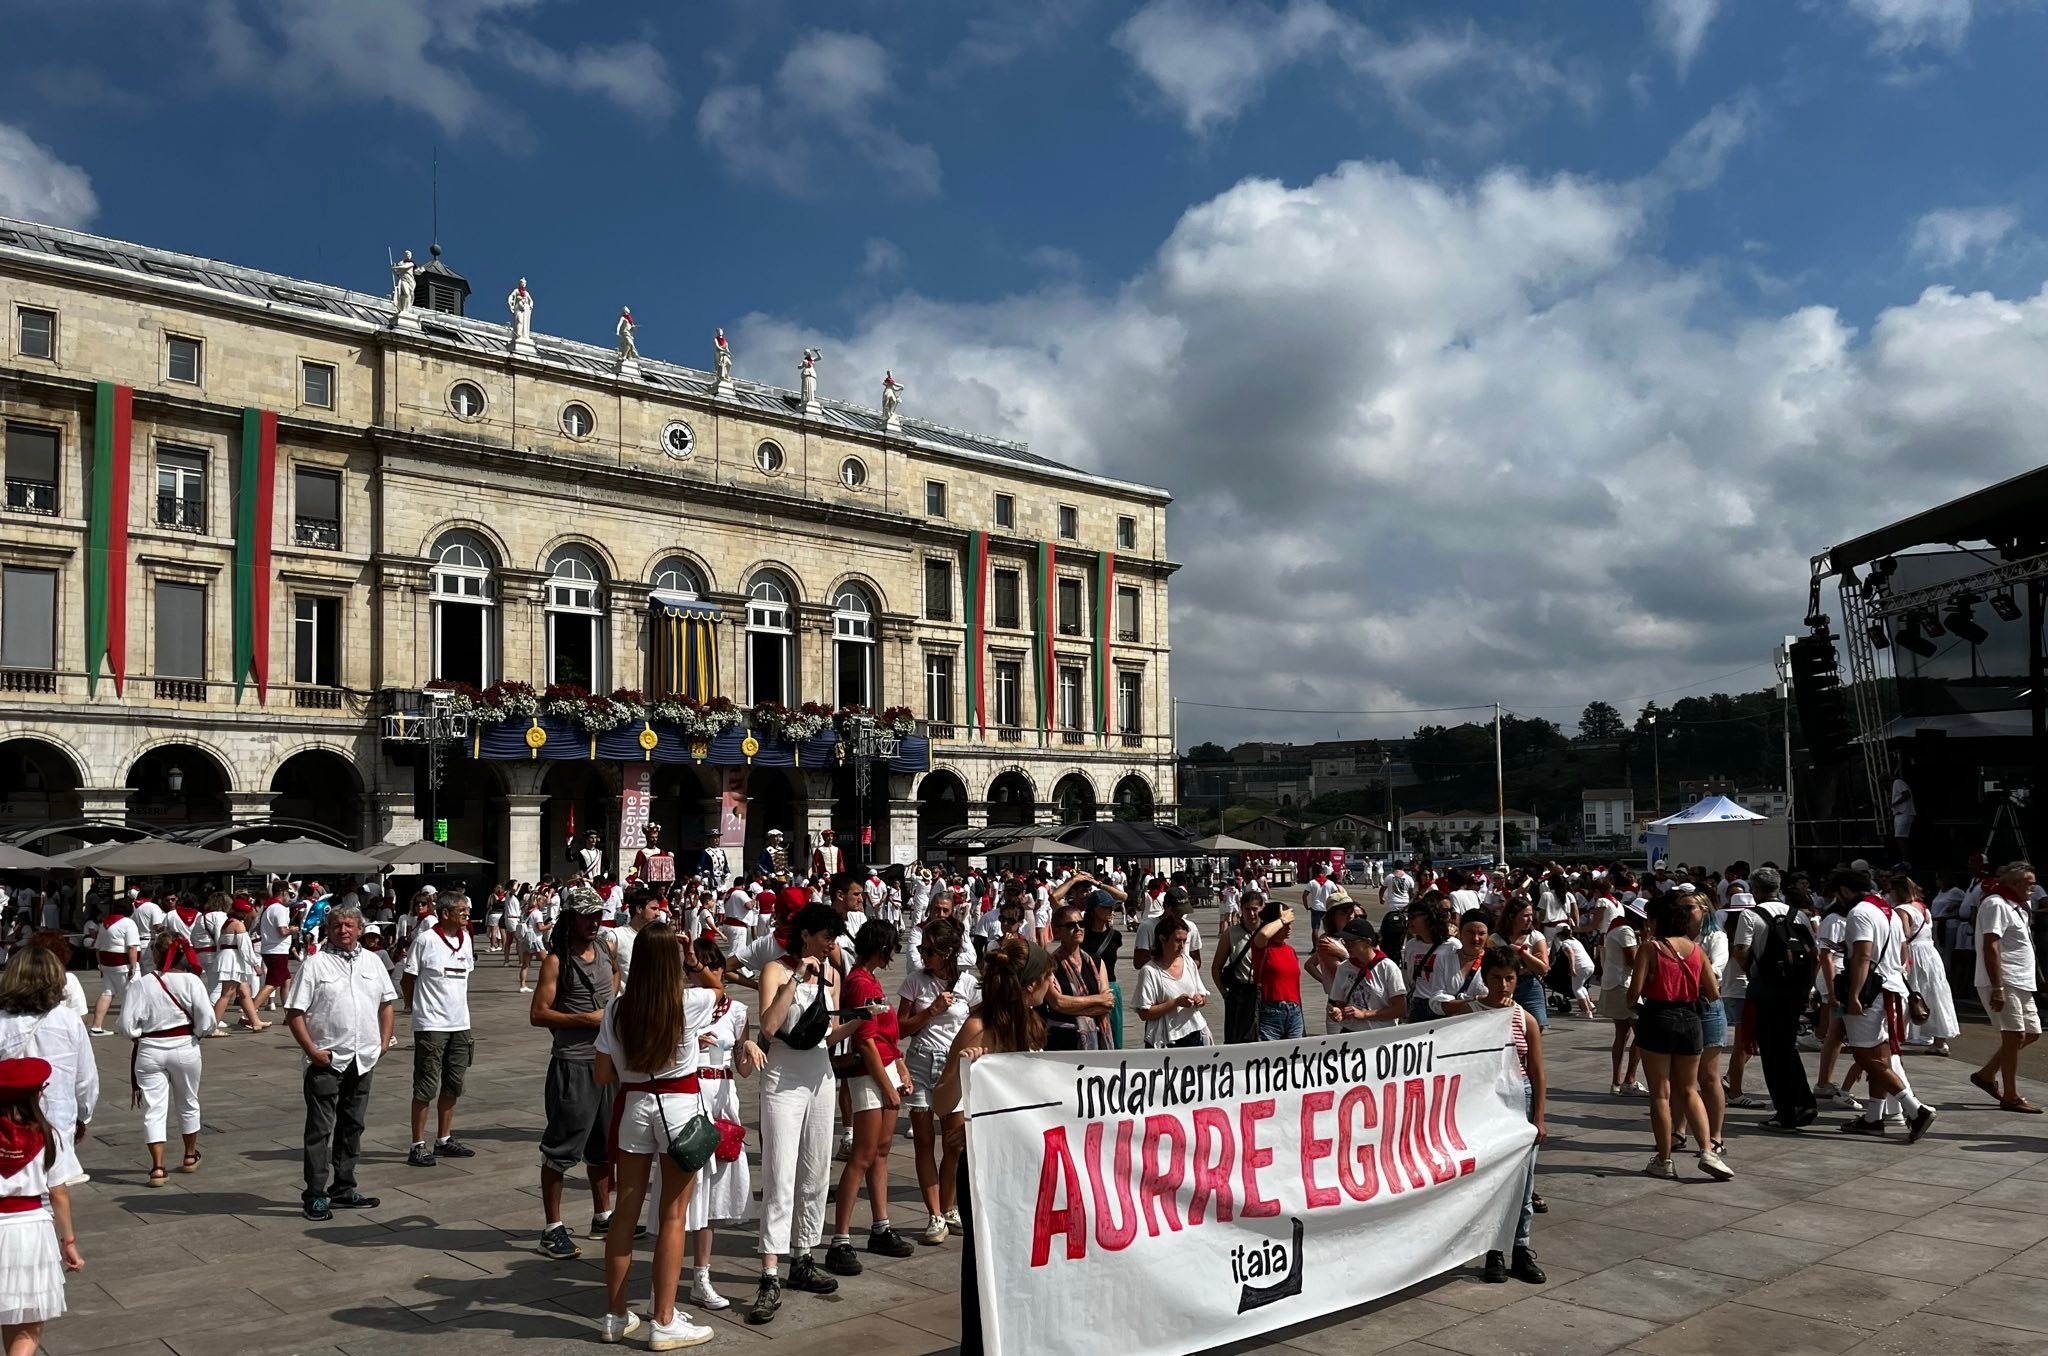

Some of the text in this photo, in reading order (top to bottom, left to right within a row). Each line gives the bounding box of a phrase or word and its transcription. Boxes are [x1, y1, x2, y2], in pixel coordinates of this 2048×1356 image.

[621, 796, 637, 847] Scène
[1076, 1029, 1434, 1119] indarkeria matxista orori
[1031, 1074, 1476, 1267] AURRE EGIN!
[1231, 1239, 1287, 1284] itaia
